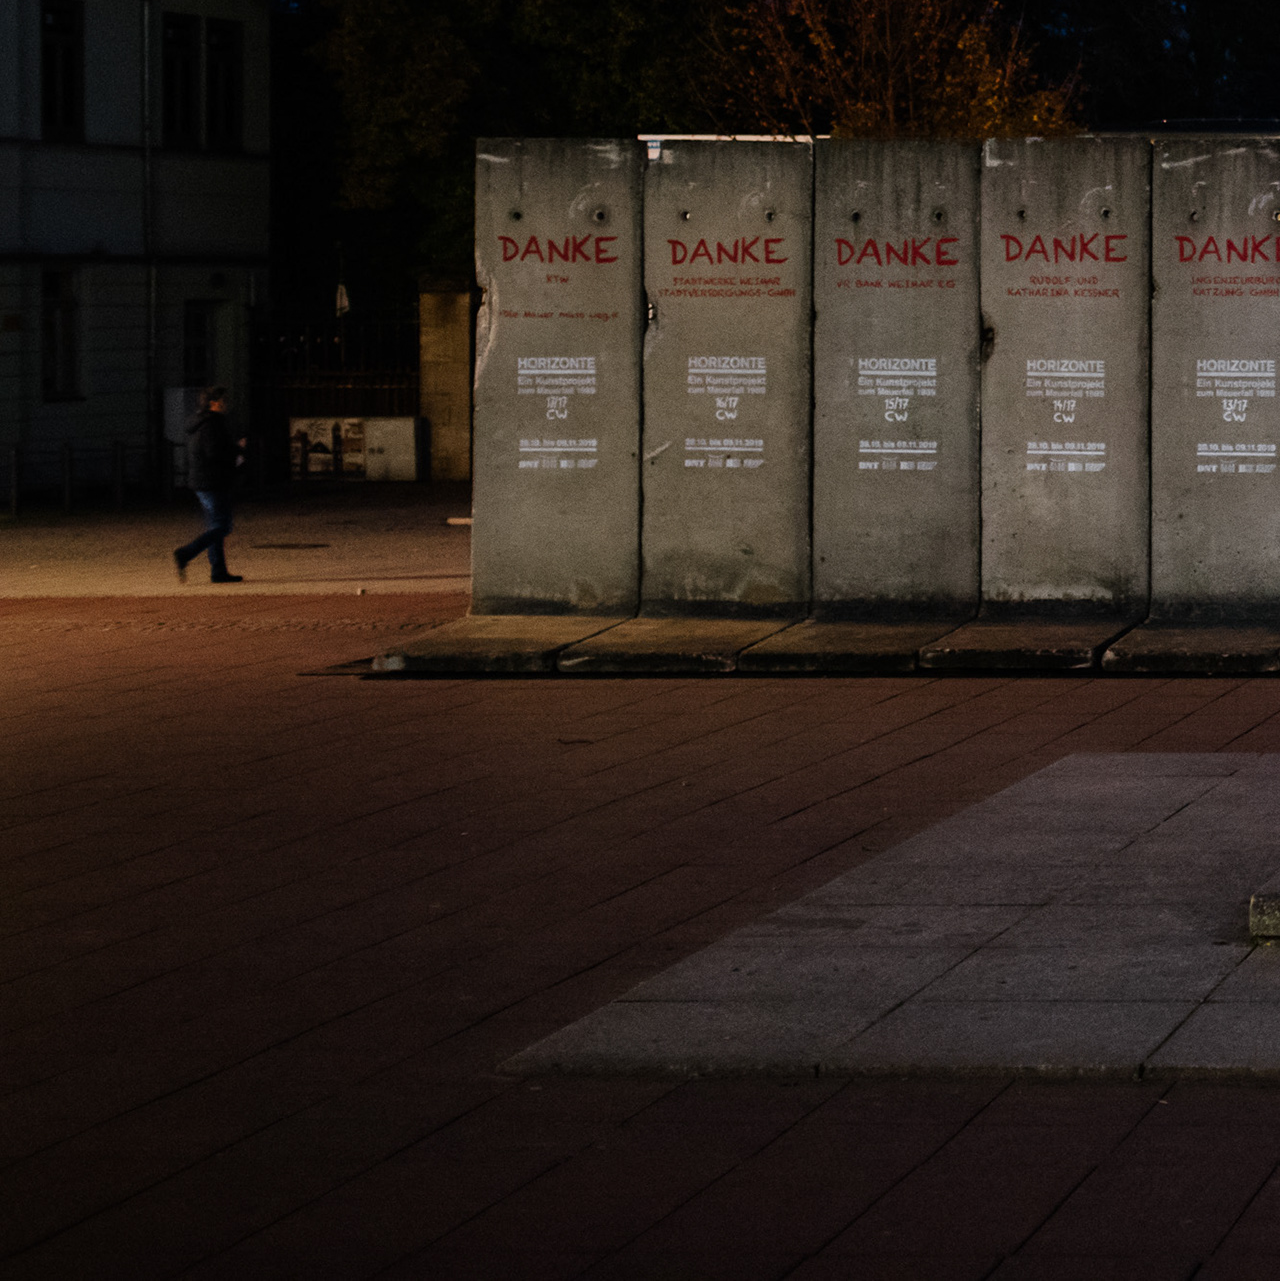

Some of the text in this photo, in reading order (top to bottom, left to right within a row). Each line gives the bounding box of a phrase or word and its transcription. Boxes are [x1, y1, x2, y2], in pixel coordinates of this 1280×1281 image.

[498, 234, 618, 264] DANKE
[667, 236, 788, 265] DANKE
[835, 237, 959, 266] DANKE
[1000, 233, 1127, 263] DANKE
[740, 277, 780, 286] WEIMAR
[856, 280, 882, 288] BANK
[888, 280, 933, 288] WEIMAR
[1030, 276, 1098, 285] RUDOLF UND
[1008, 288, 1068, 297] KATHARINA
[518, 357, 596, 368] HORIZONTE
[688, 357, 766, 368] HORIZONTE
[859, 358, 936, 370] HORIZONTE
[1027, 360, 1105, 372] HORIZONTE
[1197, 360, 1276, 371] HORIZONTE
[716, 396, 739, 408] 16/17
[885, 397, 909, 409] 15/17
[1053, 400, 1076, 411] 14/17
[1223, 399, 1248, 411] 13/17
[546, 409, 567, 420] CW
[716, 410, 738, 420] CW
[885, 411, 908, 421] CW
[1054, 412, 1075, 423] CW
[1223, 412, 1246, 422] CW
